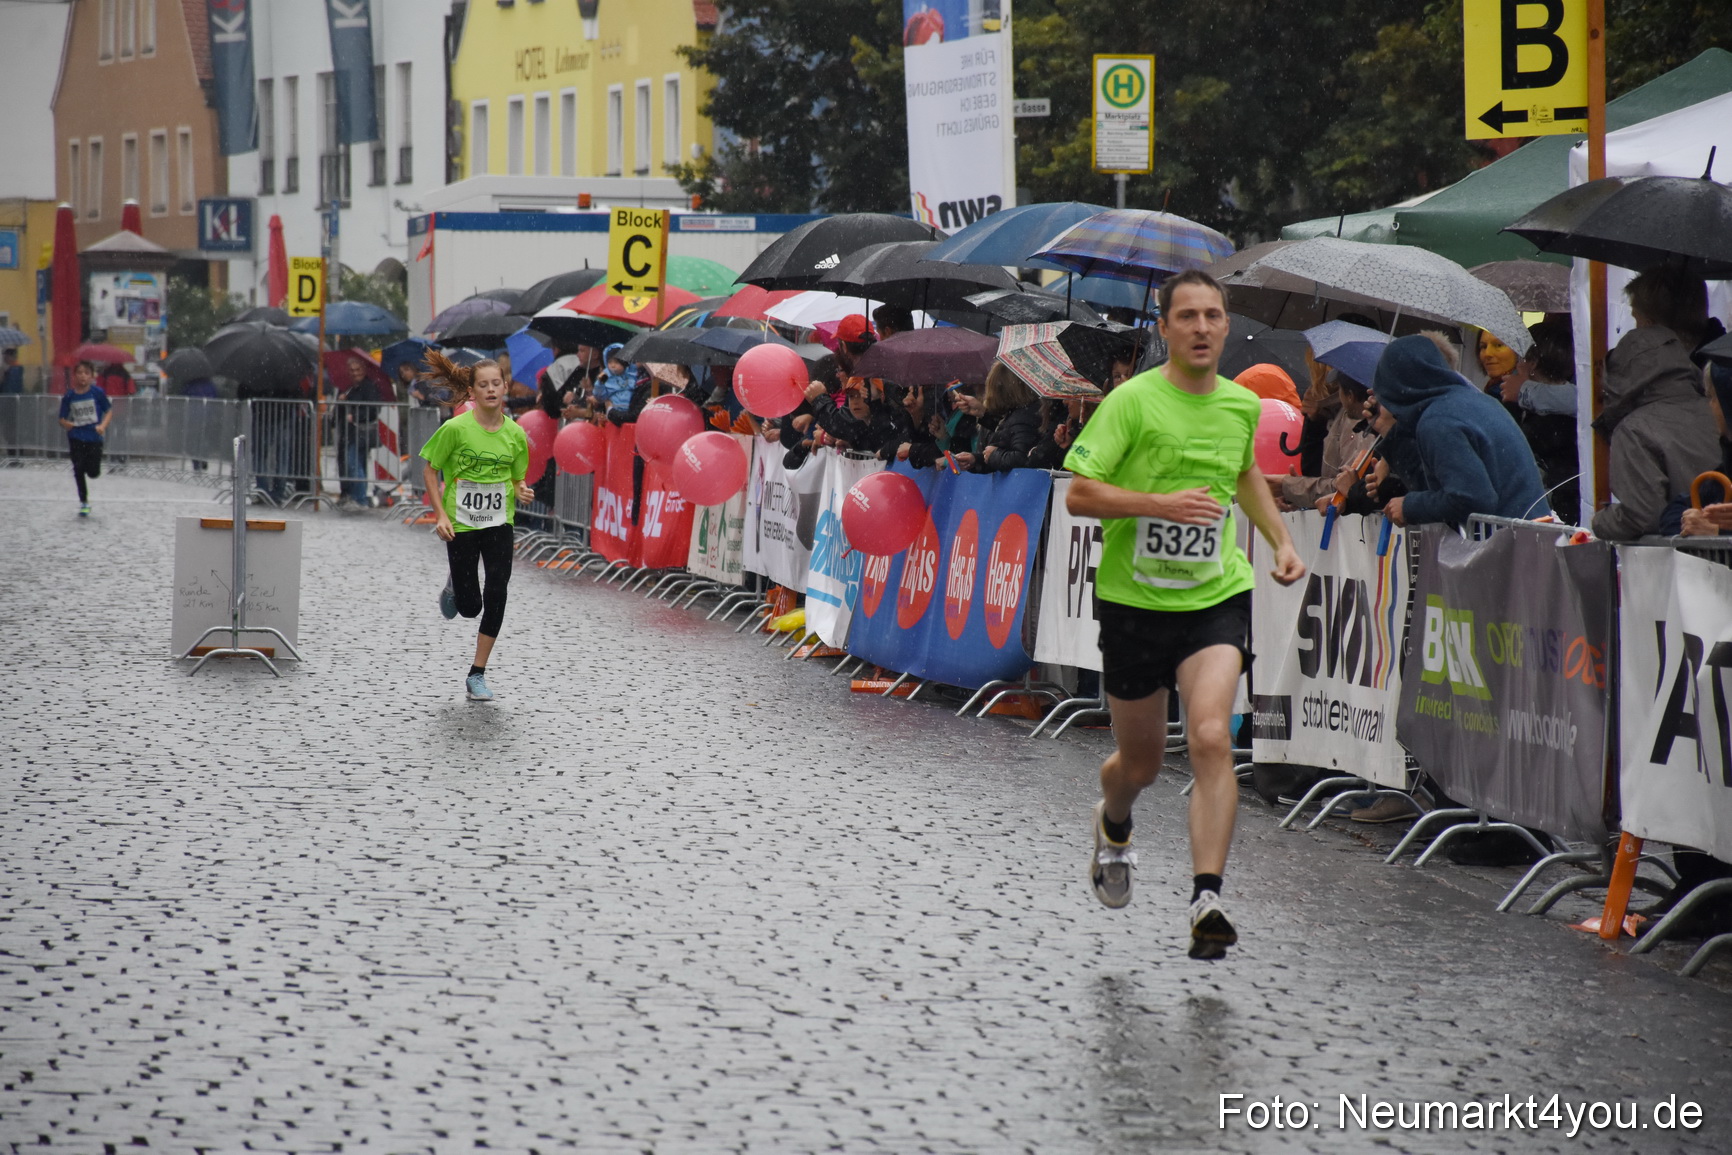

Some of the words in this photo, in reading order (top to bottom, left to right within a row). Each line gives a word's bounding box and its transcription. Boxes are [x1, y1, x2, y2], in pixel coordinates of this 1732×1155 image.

[1500, 0, 1569, 90] B
[515, 46, 548, 82] HOTEL
[1020, 102, 1047, 114] Gasse
[1104, 112, 1142, 122] Marktplatz
[616, 210, 662, 229] Block
[293, 258, 322, 270] Block
[622, 234, 653, 278] C
[298, 274, 317, 303] D
[462, 492, 503, 510] 4013
[469, 513, 494, 523] Victoria
[1146, 522, 1217, 558] 5325
[986, 540, 1023, 623] Hervis
[179, 585, 212, 597] Runde
[249, 585, 277, 598] Ziel
